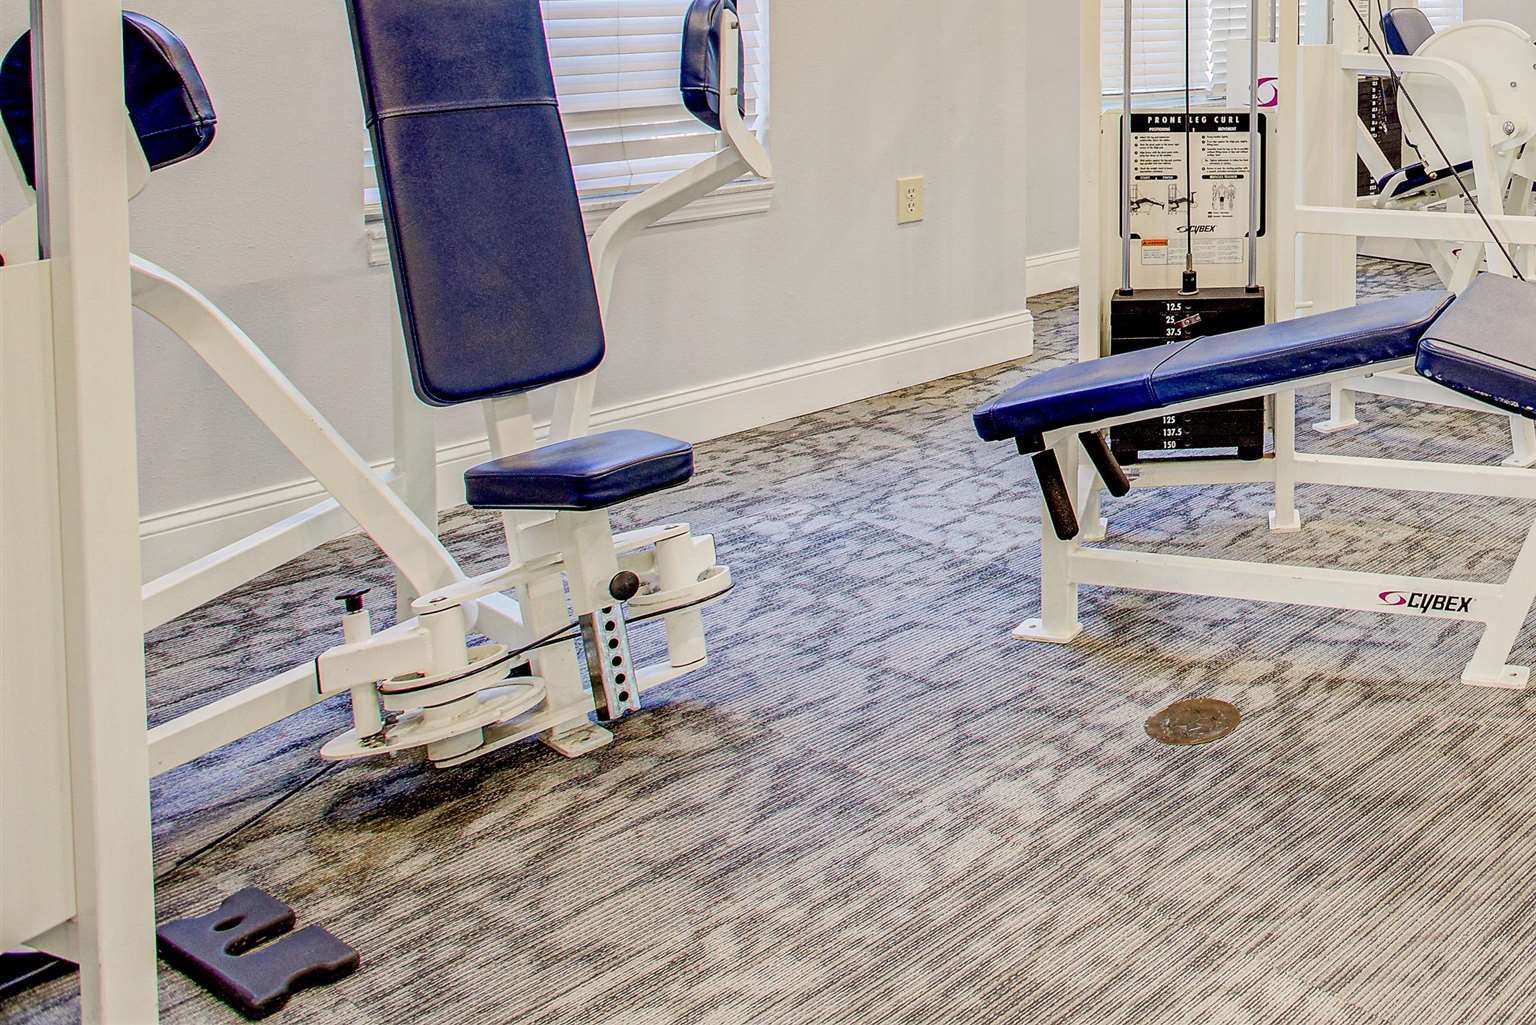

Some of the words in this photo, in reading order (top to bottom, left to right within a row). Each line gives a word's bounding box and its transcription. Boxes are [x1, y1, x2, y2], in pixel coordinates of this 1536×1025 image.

[1147, 116, 1182, 124] PRONE
[1189, 116, 1207, 124] LEG
[1214, 116, 1240, 124] CURL
[1189, 225, 1217, 234] CYBEX
[1166, 303, 1182, 311] 12.5
[1166, 316, 1175, 324] 25
[1166, 328, 1182, 336] 37.5
[1163, 416, 1176, 424] 125
[1163, 428, 1182, 436] 137.5
[1163, 441, 1176, 449] 150
[1407, 592, 1473, 614] CYBEX
